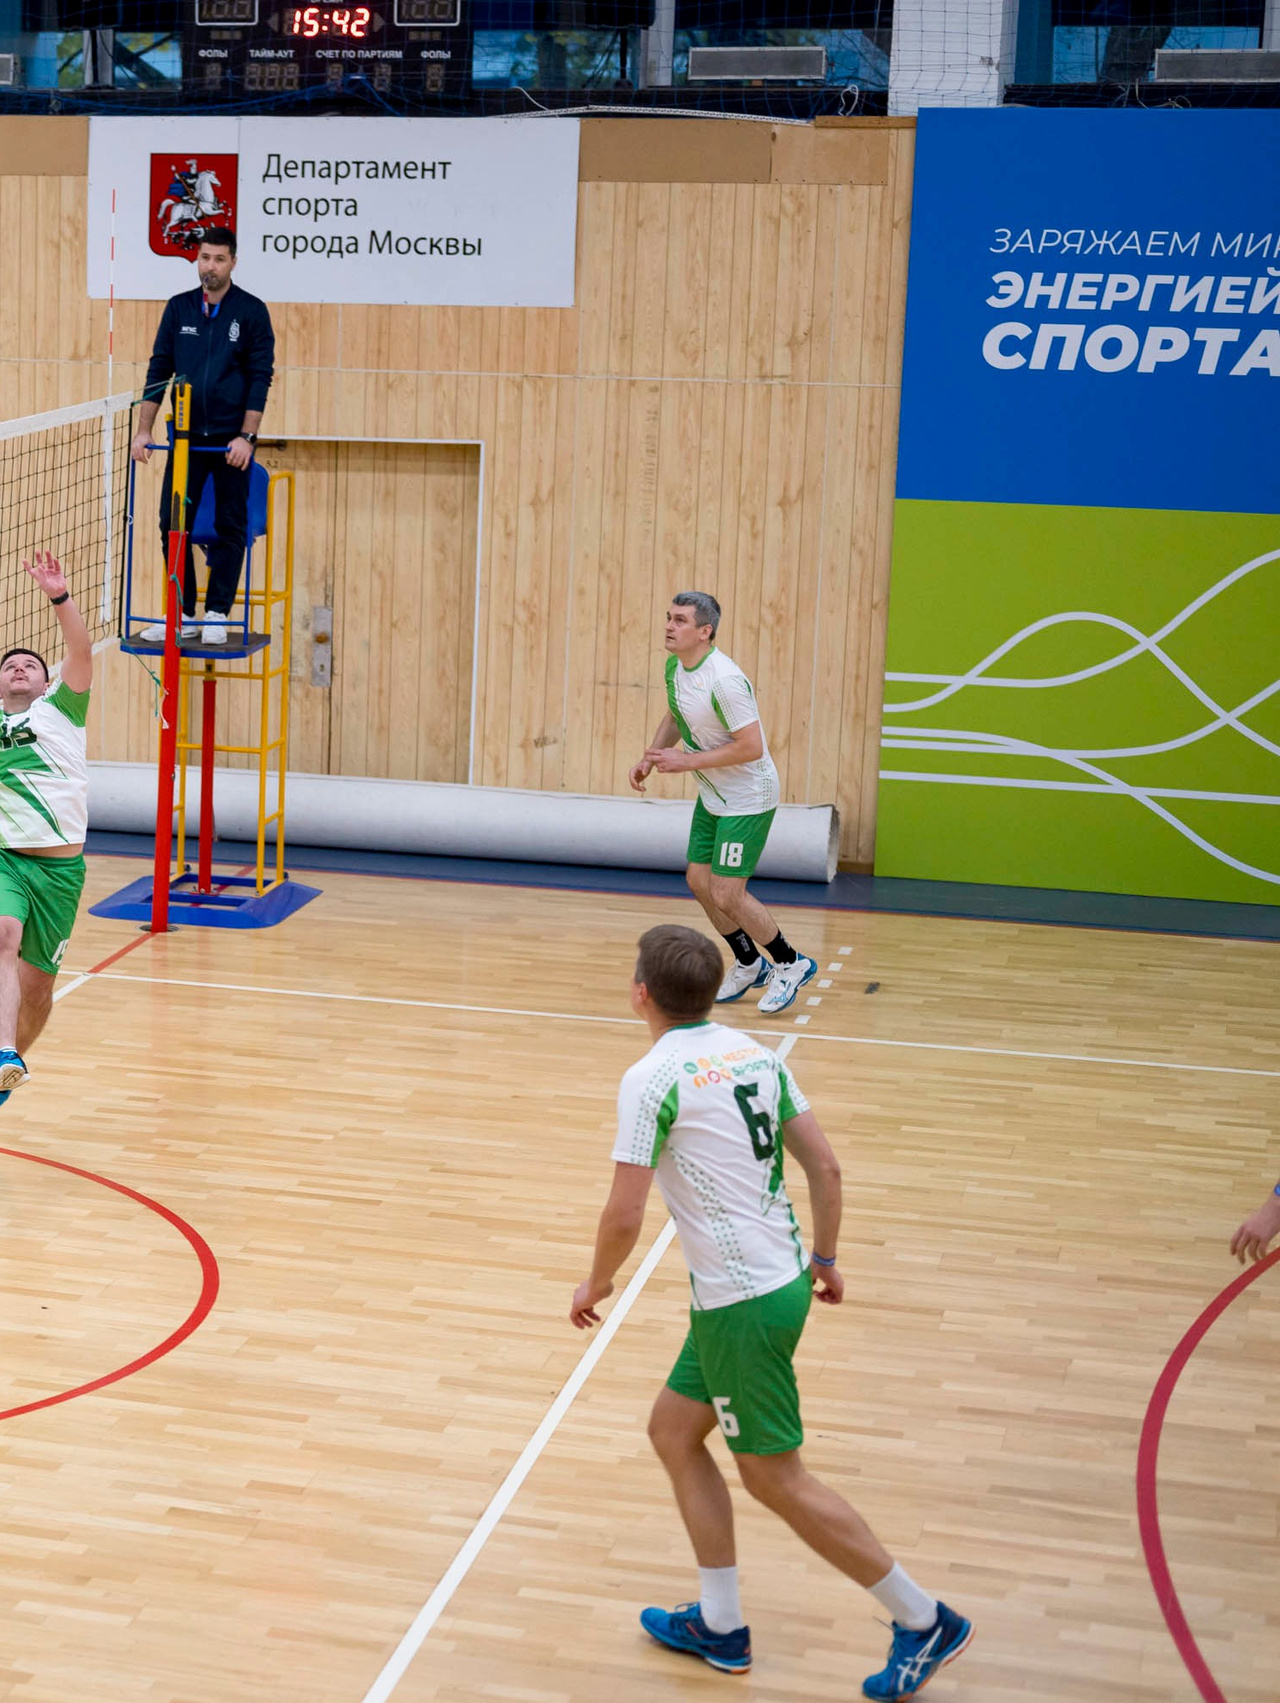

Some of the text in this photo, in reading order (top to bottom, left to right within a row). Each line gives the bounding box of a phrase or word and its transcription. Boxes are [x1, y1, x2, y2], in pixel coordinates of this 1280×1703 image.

[292, 7, 370, 37] 15:42
[249, 48, 295, 58] ТАЙМ-АУТ
[315, 49, 403, 59] СЧЕТ ПО ПАРТИЯМ
[262, 154, 452, 185] Департамент
[262, 195, 359, 222] спорта
[262, 230, 483, 259] города Москвы
[989, 228, 1201, 257] ЗАРЯЖАЕМ
[985, 266, 1280, 315] ЭНЕРГИЕЙ
[982, 321, 1280, 377] СПОРТА
[719, 841, 744, 867] 18
[733, 1082, 777, 1161] 6
[712, 1396, 740, 1437] 6
